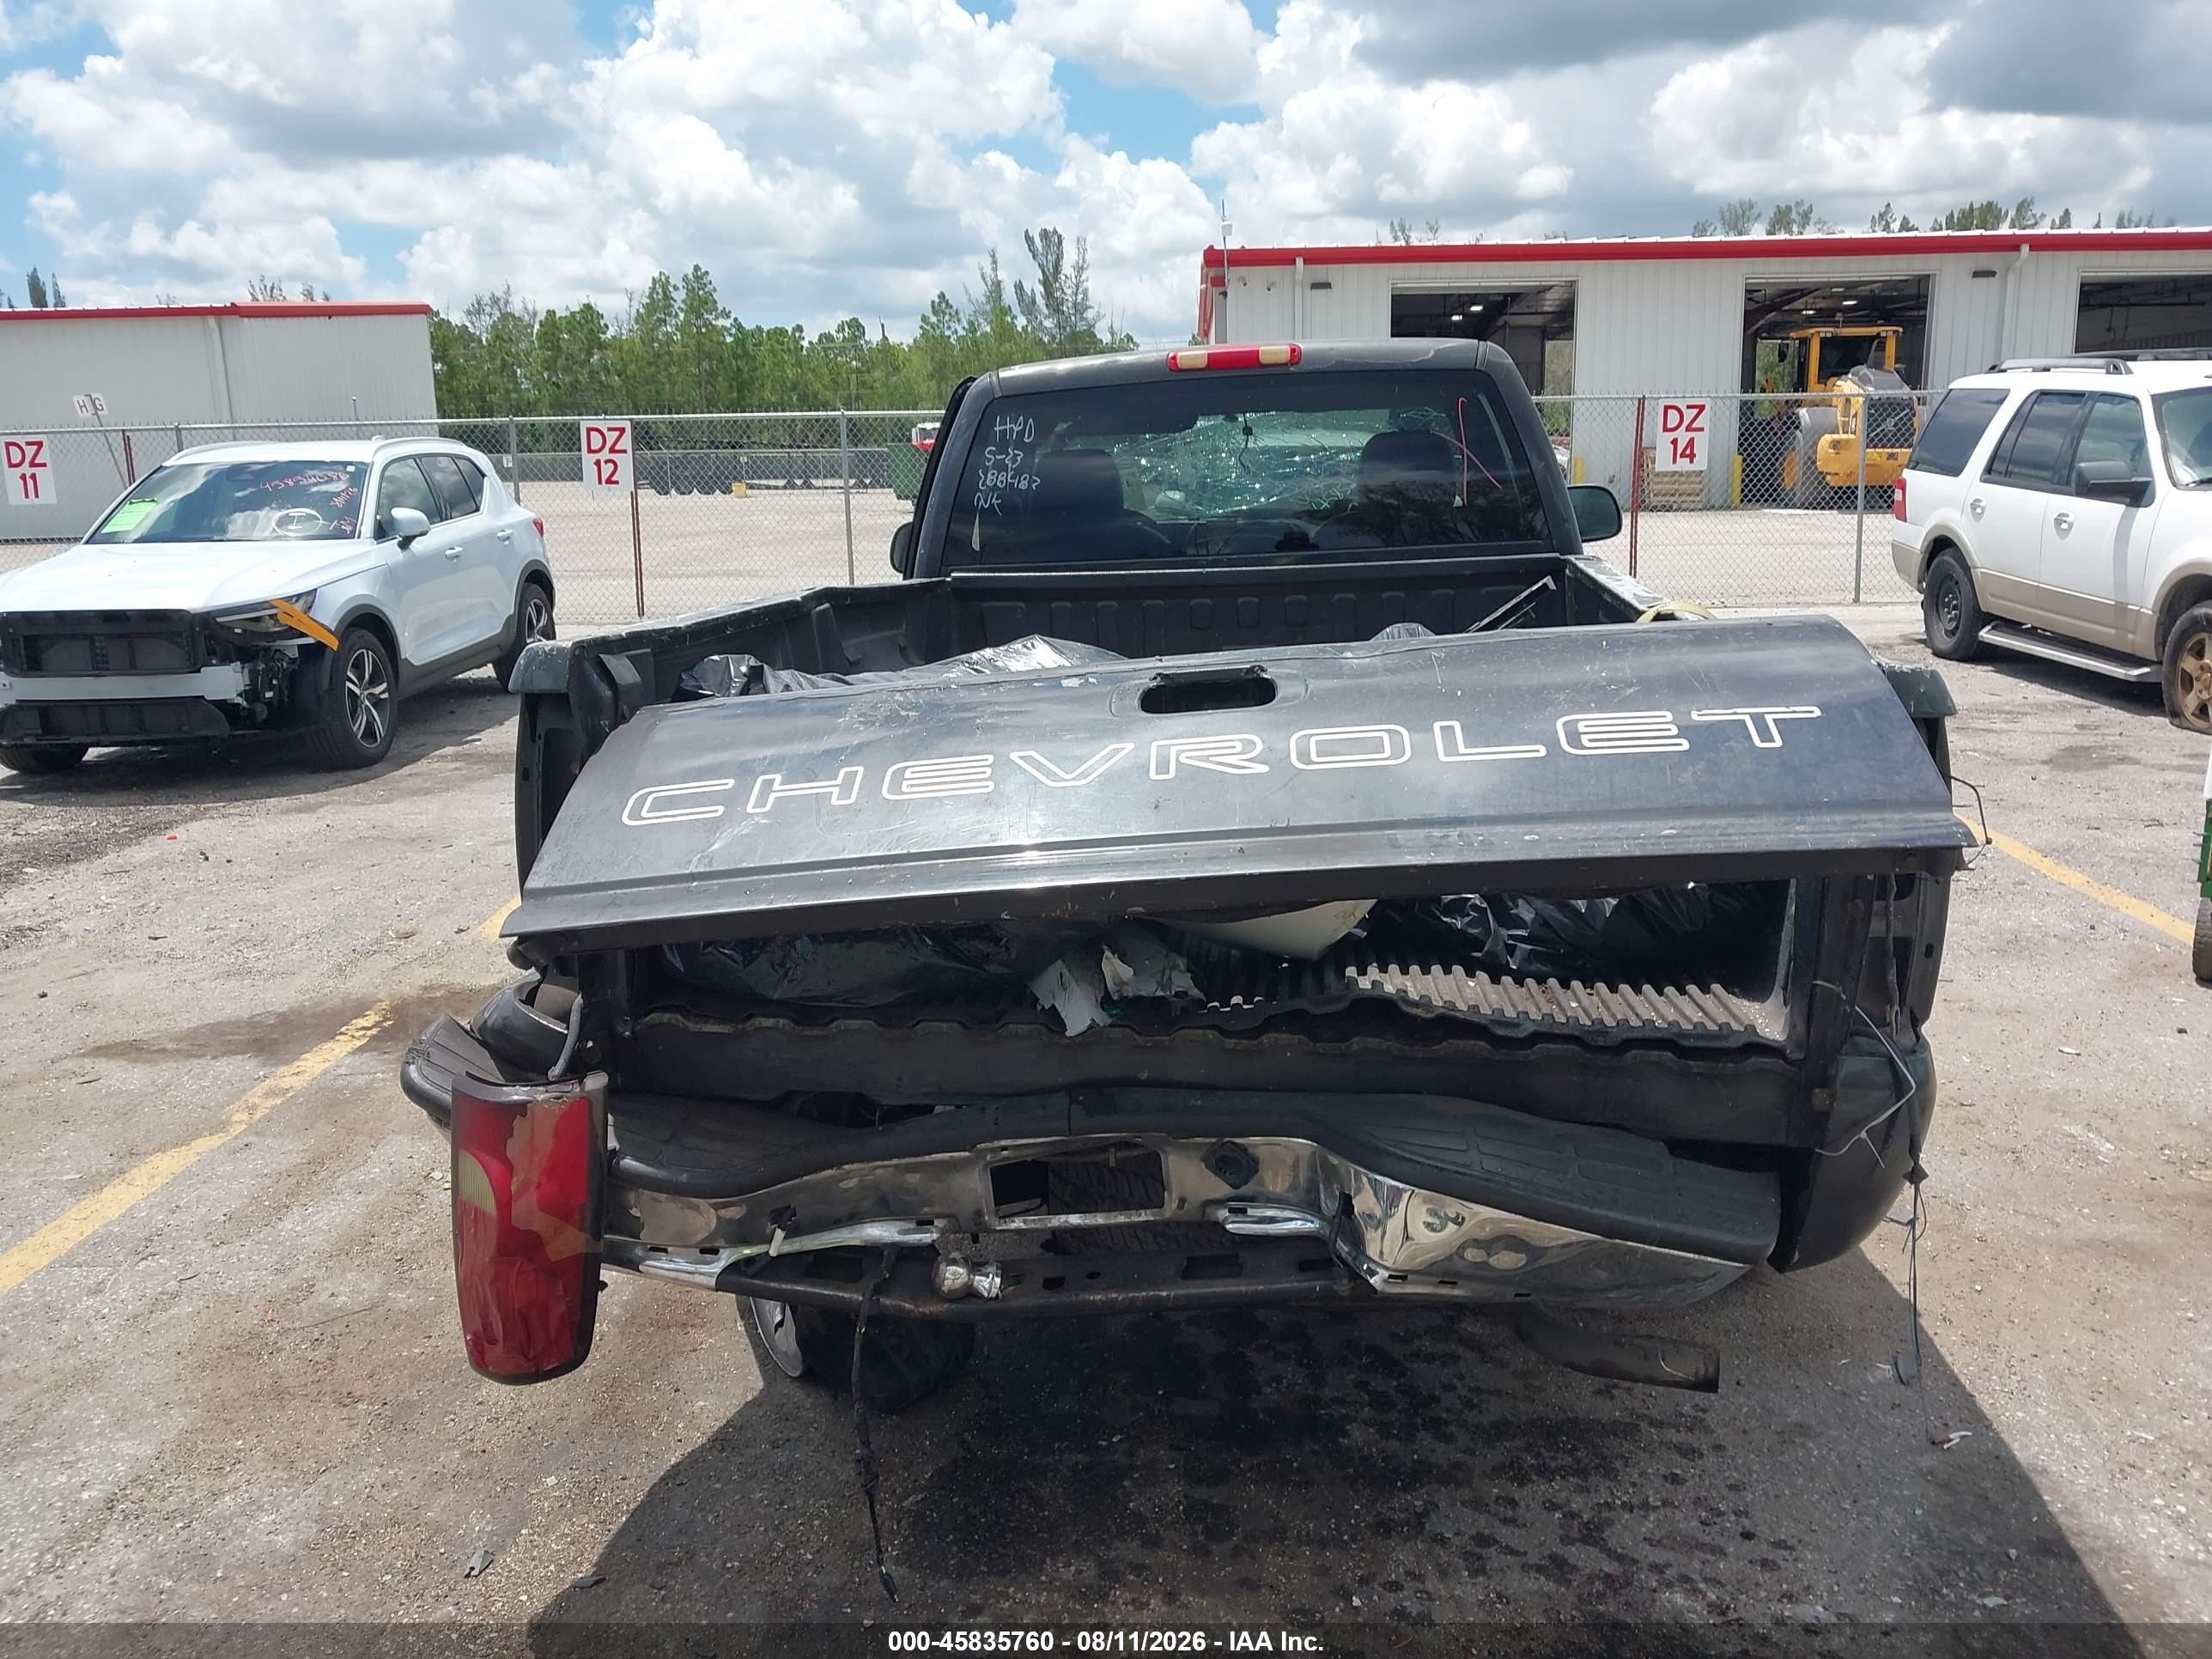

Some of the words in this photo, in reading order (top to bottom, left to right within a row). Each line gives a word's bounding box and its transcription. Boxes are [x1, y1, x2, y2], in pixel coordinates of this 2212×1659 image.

[76, 399, 89, 414] H
[93, 397, 105, 412] G
[1662, 404, 1706, 433] DZ
[586, 426, 628, 453] DZ
[1669, 436, 1697, 465] 14
[4, 440, 47, 469] DZ
[592, 458, 620, 485] 12
[19, 472, 40, 499] 11
[621, 705, 1822, 826] CHEVROLET
